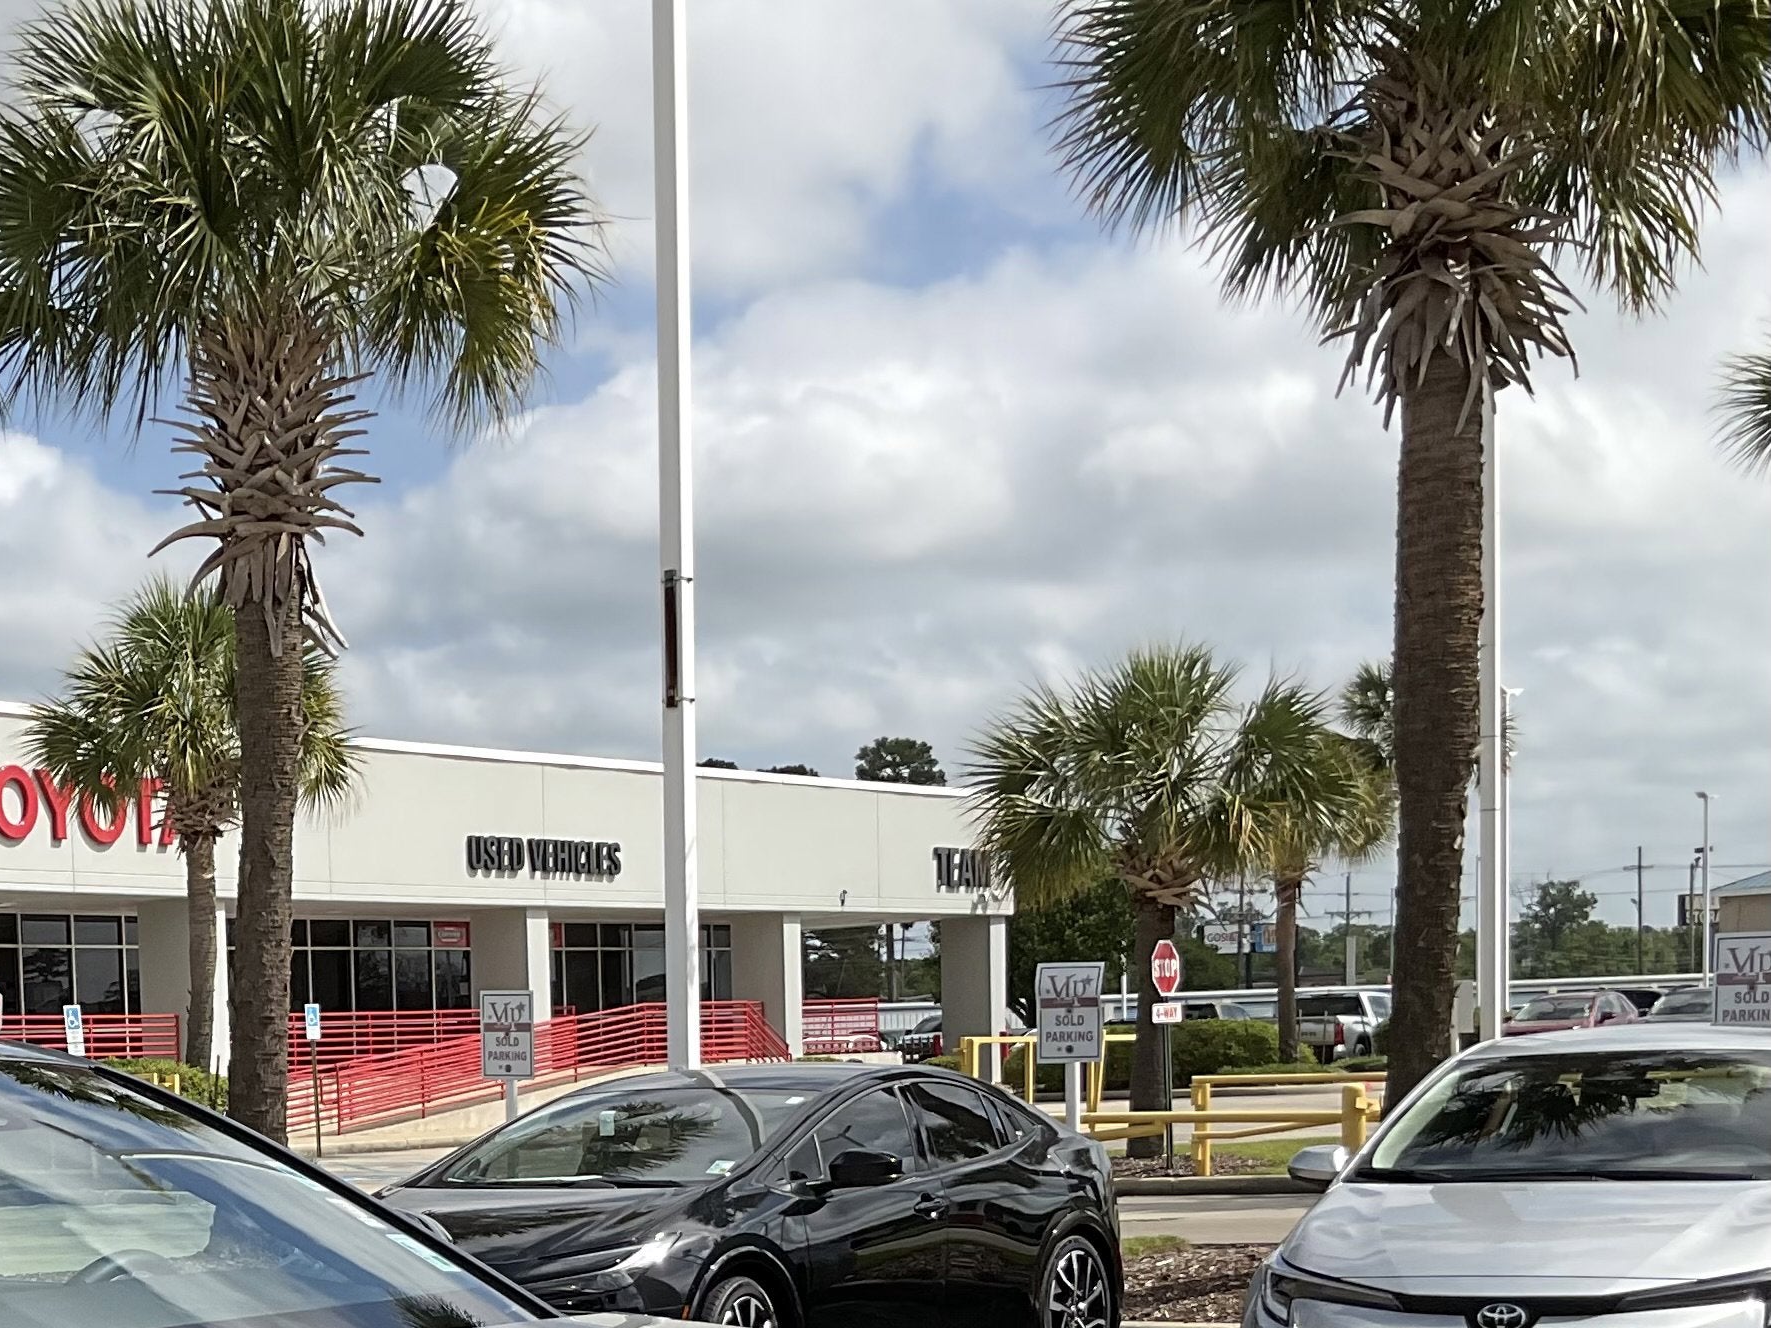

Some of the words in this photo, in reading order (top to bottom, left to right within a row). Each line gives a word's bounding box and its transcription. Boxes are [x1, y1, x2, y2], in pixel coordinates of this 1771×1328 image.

[466, 835, 525, 871] USED
[526, 838, 621, 876] VEHICLES
[1154, 958, 1177, 978] STOP
[1734, 990, 1770, 1004] SOLD
[1155, 1006, 1178, 1019] 4-WAY
[1722, 1008, 1771, 1023] PARKIN
[1054, 1014, 1085, 1026] SOLD
[495, 1036, 520, 1047] SOLD
[1045, 1030, 1095, 1042] PARKING
[487, 1050, 528, 1062] PARKING
